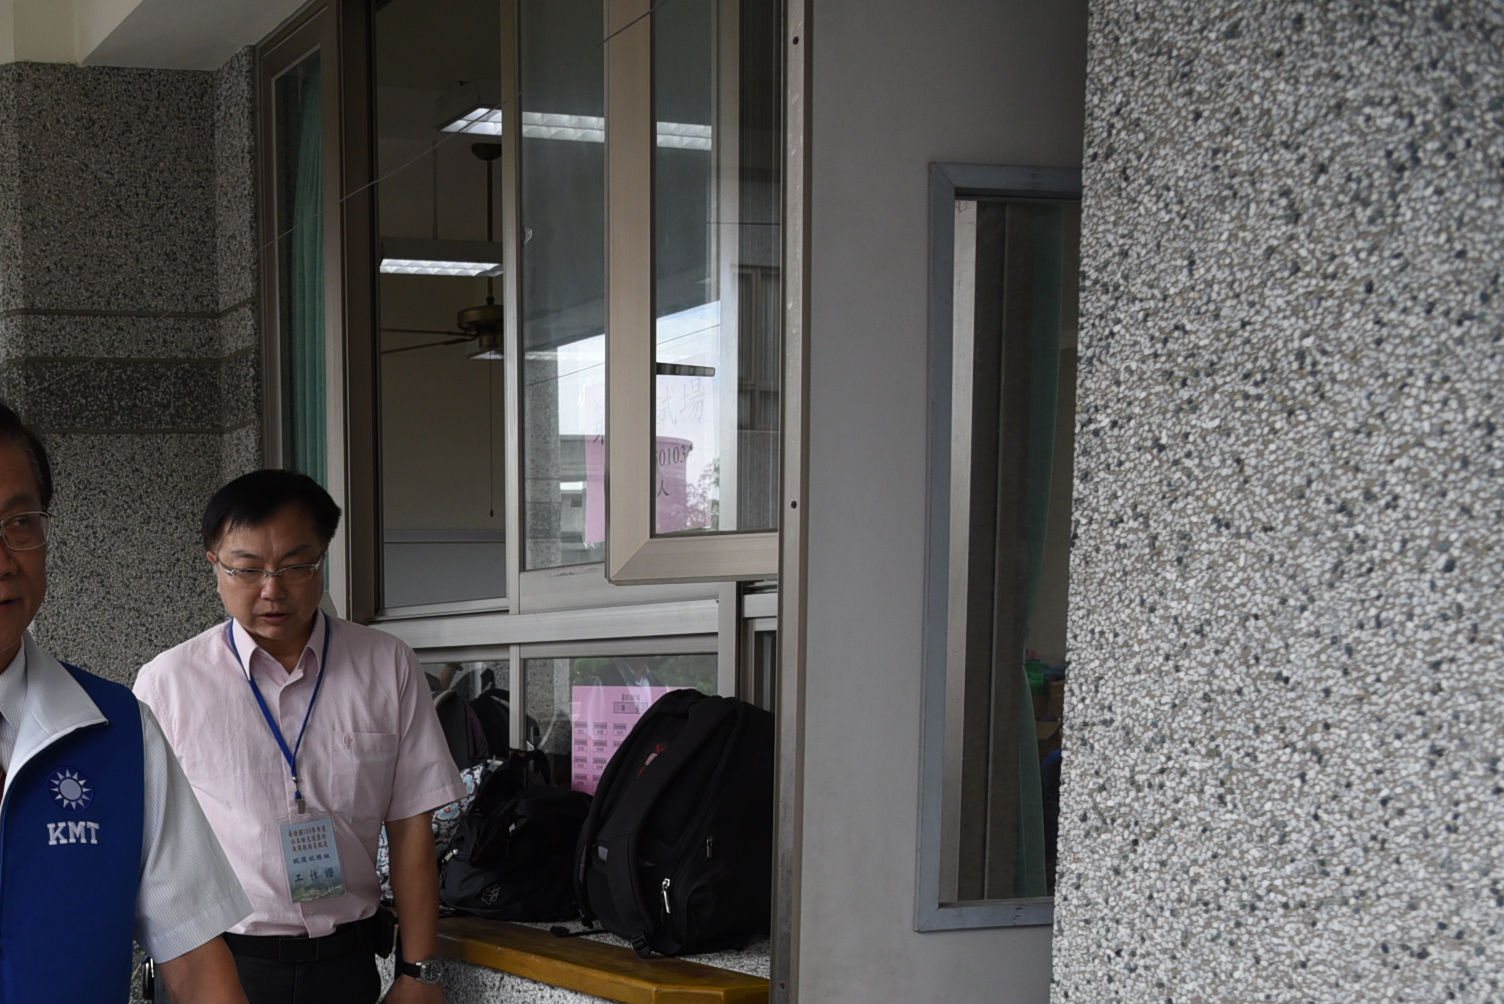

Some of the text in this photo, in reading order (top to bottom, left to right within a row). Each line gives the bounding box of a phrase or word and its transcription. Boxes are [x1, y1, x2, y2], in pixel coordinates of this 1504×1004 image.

[47, 821, 100, 846] KMT
[294, 867, 335, 883] 工作證
